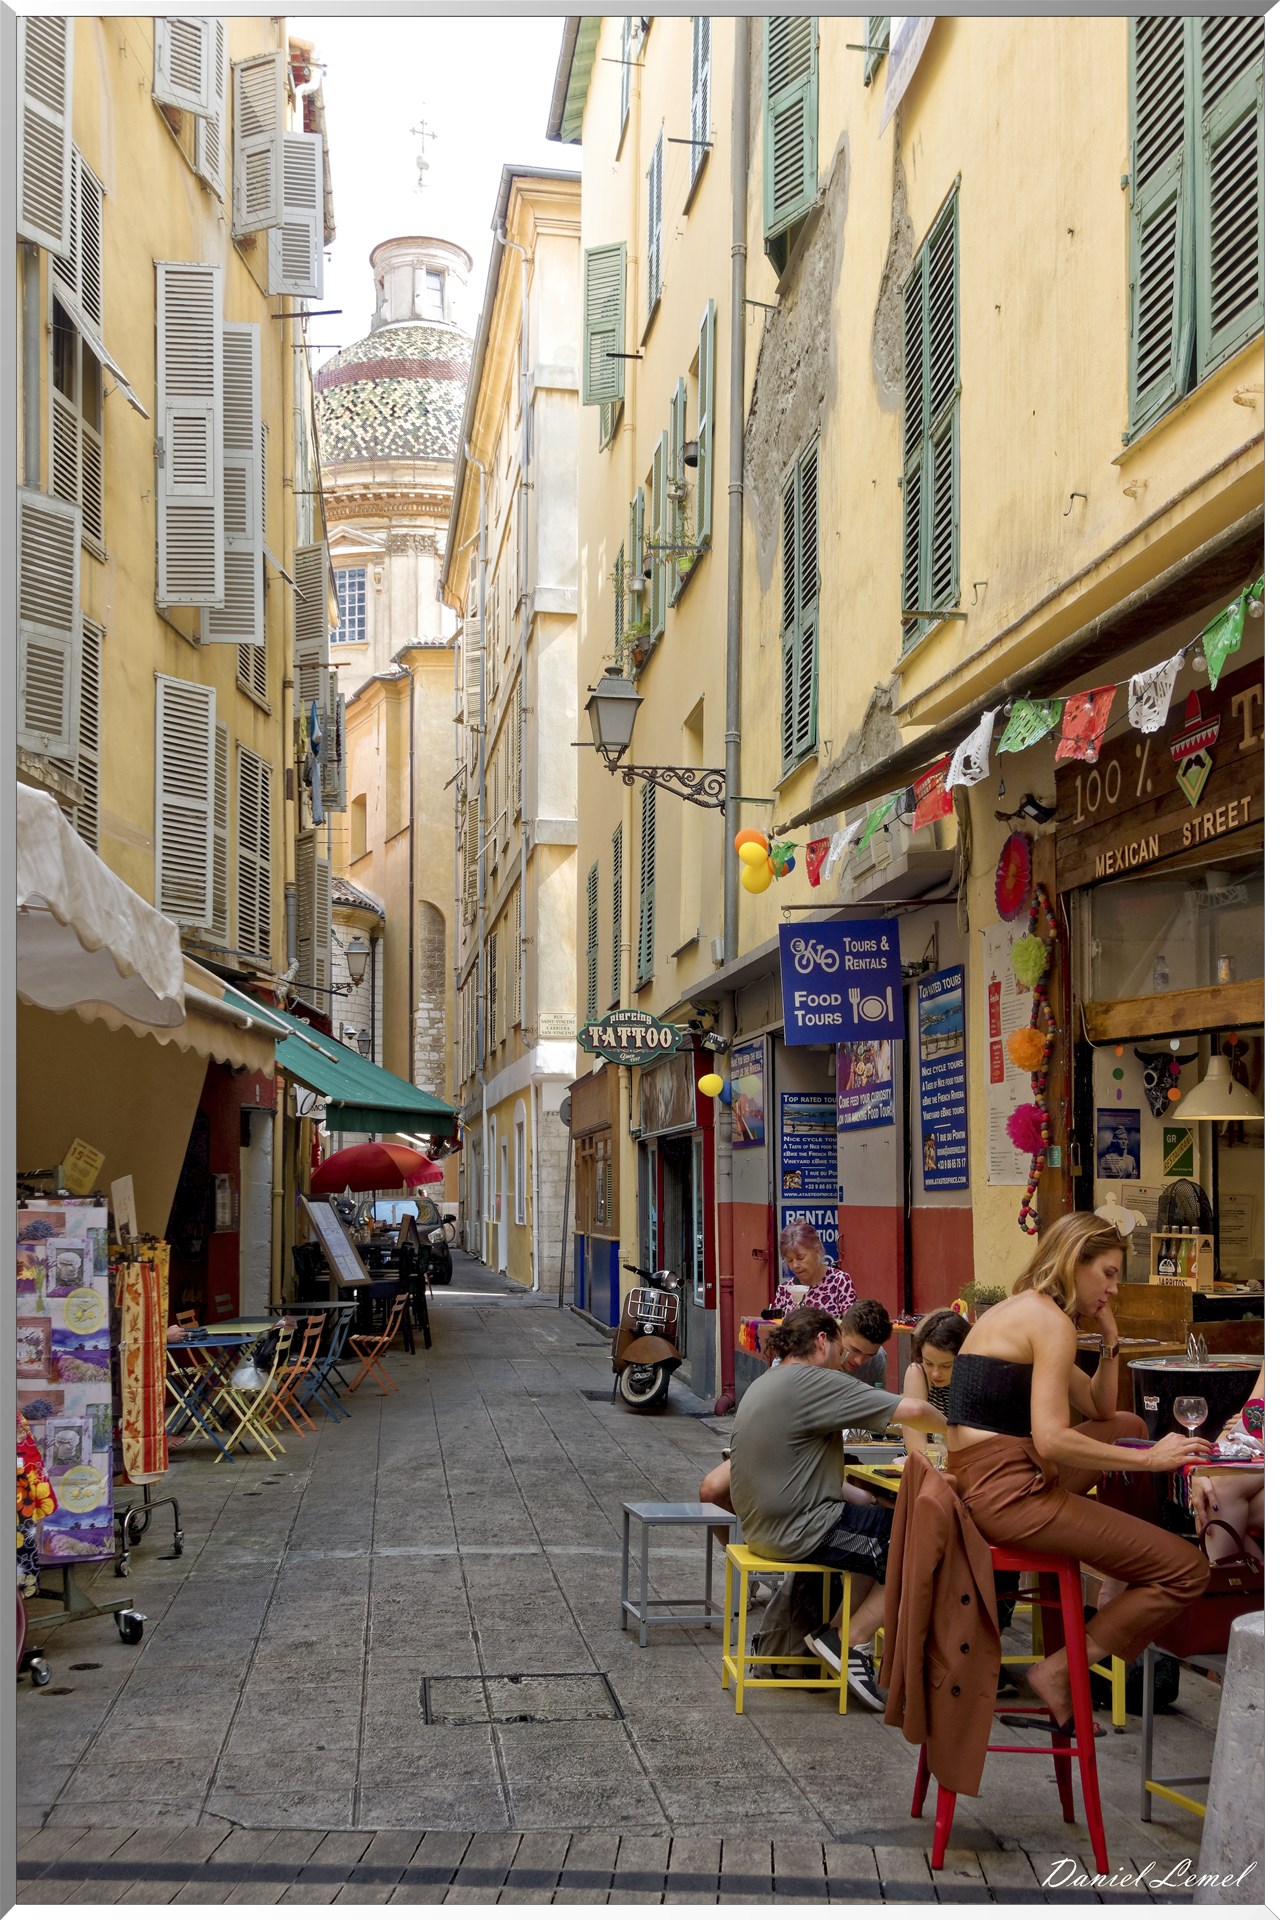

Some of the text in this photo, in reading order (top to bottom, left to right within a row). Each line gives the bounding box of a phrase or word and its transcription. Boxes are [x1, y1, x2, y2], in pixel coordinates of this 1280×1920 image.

[1073, 738, 1153, 825] 100 %
[1095, 795, 1252, 878] MEXICAN STREET
[880, 936, 890, 950] &
[942, 974, 962, 990] TOURS
[588, 1026, 672, 1048] TATTOO
[947, 1060, 963, 1069] TOURS
[783, 1094, 798, 1103] TOP
[1166, 1134, 1176, 1143] GR
